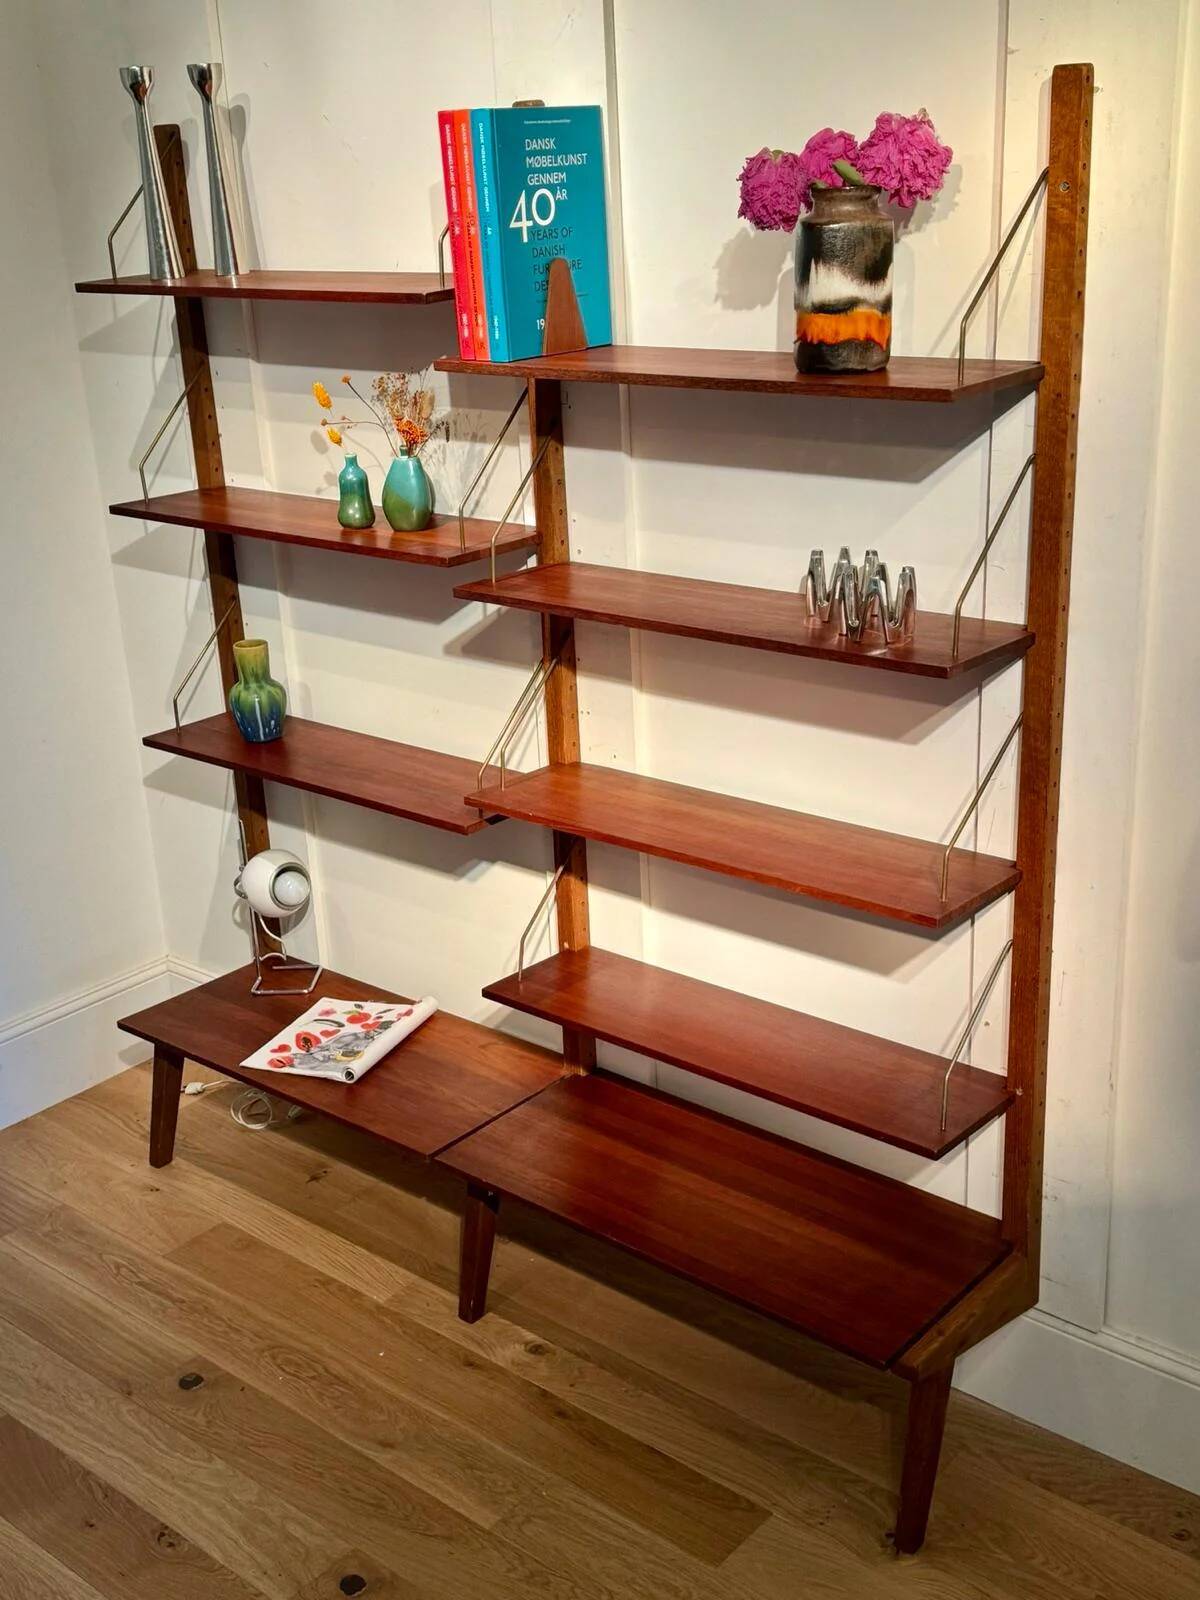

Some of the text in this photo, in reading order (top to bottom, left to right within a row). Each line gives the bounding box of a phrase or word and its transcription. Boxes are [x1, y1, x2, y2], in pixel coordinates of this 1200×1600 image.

[525, 138, 556, 151] DANSK
[526, 153, 587, 168] MØBELKUNST
[527, 172, 567, 186] GENNEM
[509, 186, 568, 243] 40 ÅR
[530, 226, 573, 241] YEARS OF
[532, 244, 565, 258] DANISH
